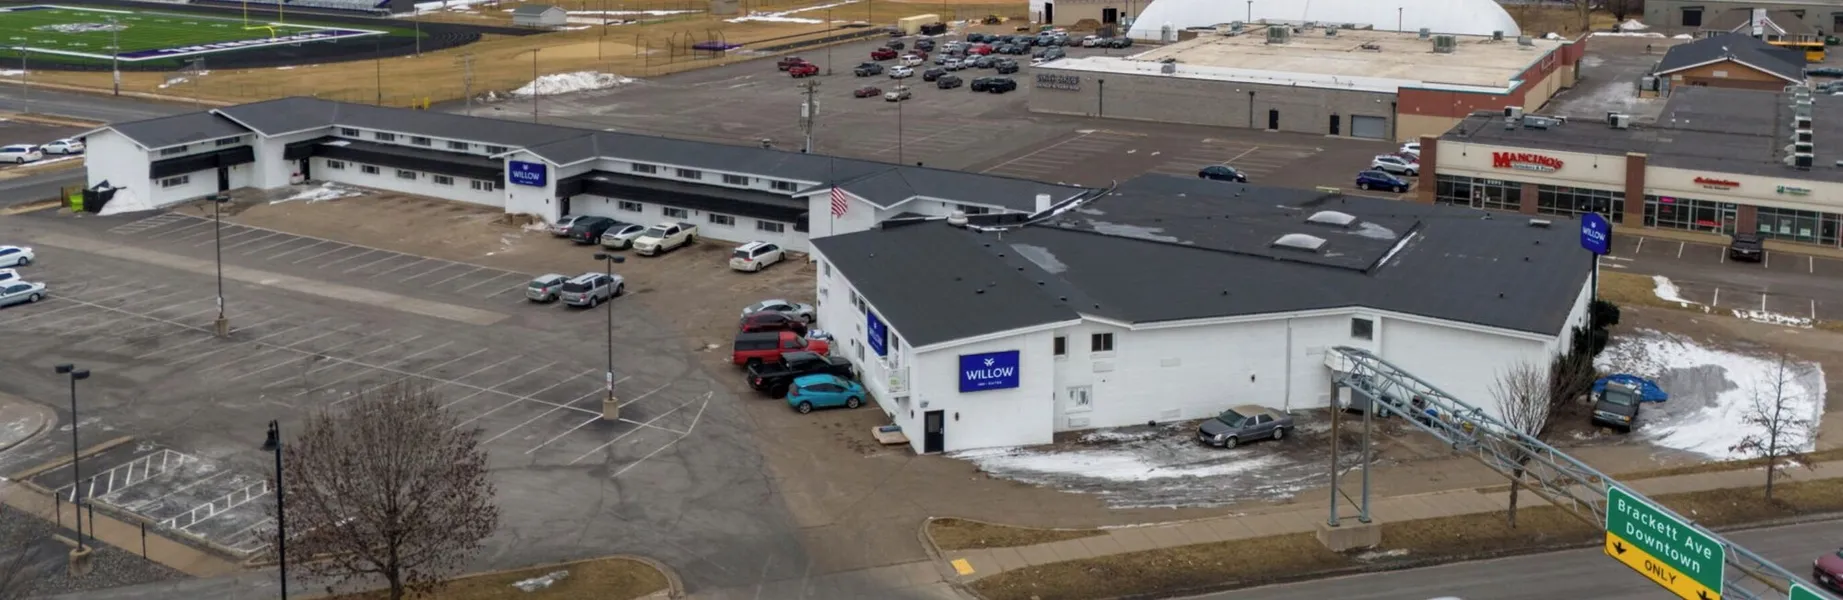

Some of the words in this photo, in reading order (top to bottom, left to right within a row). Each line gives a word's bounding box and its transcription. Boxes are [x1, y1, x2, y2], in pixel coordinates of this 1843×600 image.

[512, 170, 540, 180] WILLOW
[1583, 226, 1606, 241] WILLOW
[966, 366, 1014, 381] WILLOW
[1618, 499, 1678, 541] Brackett
[1684, 536, 1712, 560] Ave
[1626, 522, 1701, 573] Downtown
[1644, 559, 1677, 585] ONLY
